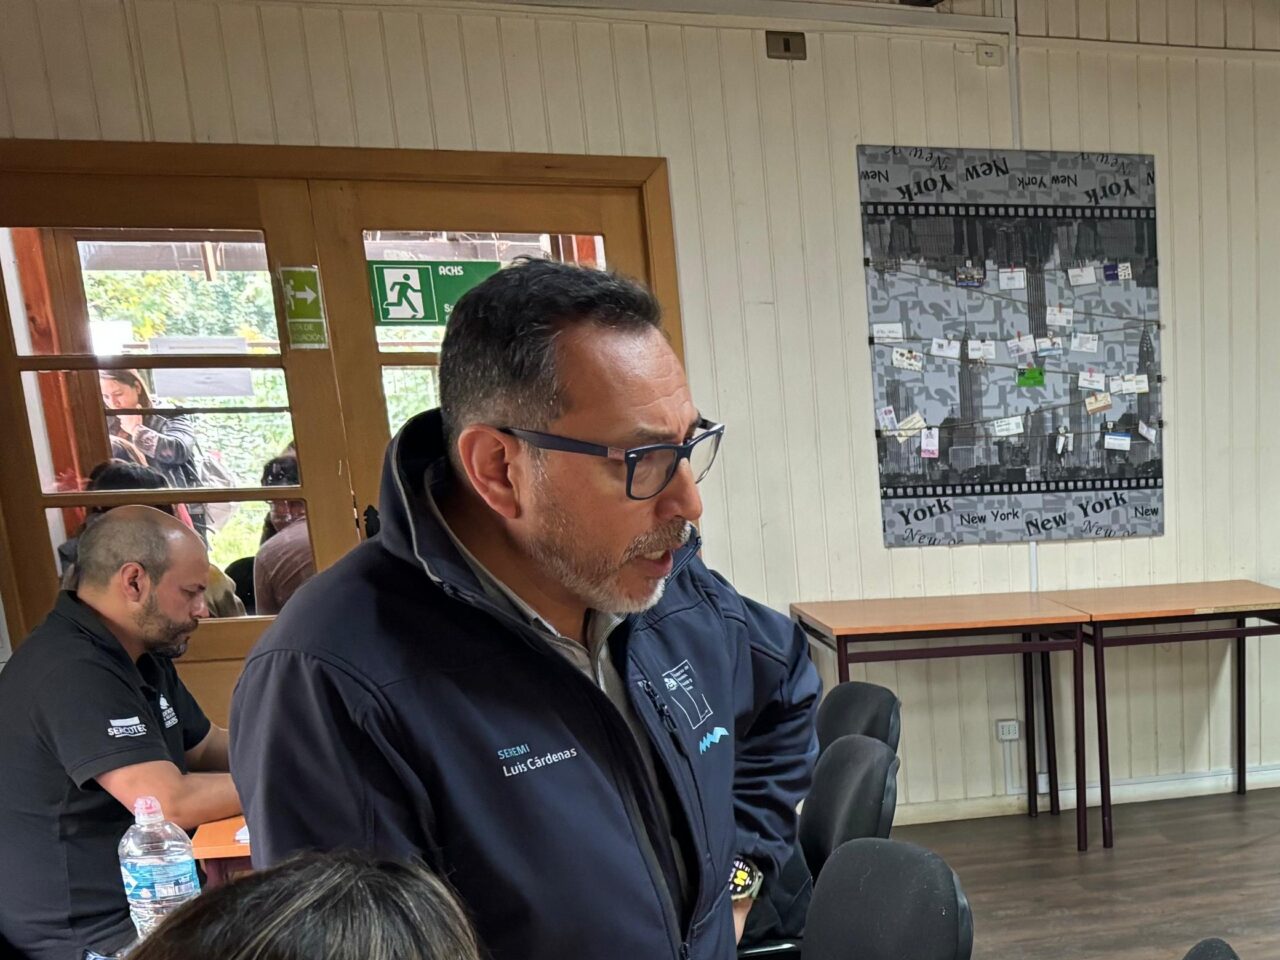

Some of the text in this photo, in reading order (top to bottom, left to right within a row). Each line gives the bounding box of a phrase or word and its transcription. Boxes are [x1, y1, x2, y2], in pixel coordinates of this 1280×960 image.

[964, 156, 1010, 182] New
[896, 174, 954, 202] York
[1084, 178, 1136, 206] York
[438, 265, 464, 276] ACHS
[897, 497, 952, 527] York
[959, 509, 1020, 526] New York
[1078, 491, 1128, 519] York
[1134, 505, 1160, 518] New
[1025, 512, 1068, 537] New
[502, 747, 578, 777] Luis Cárdenas
